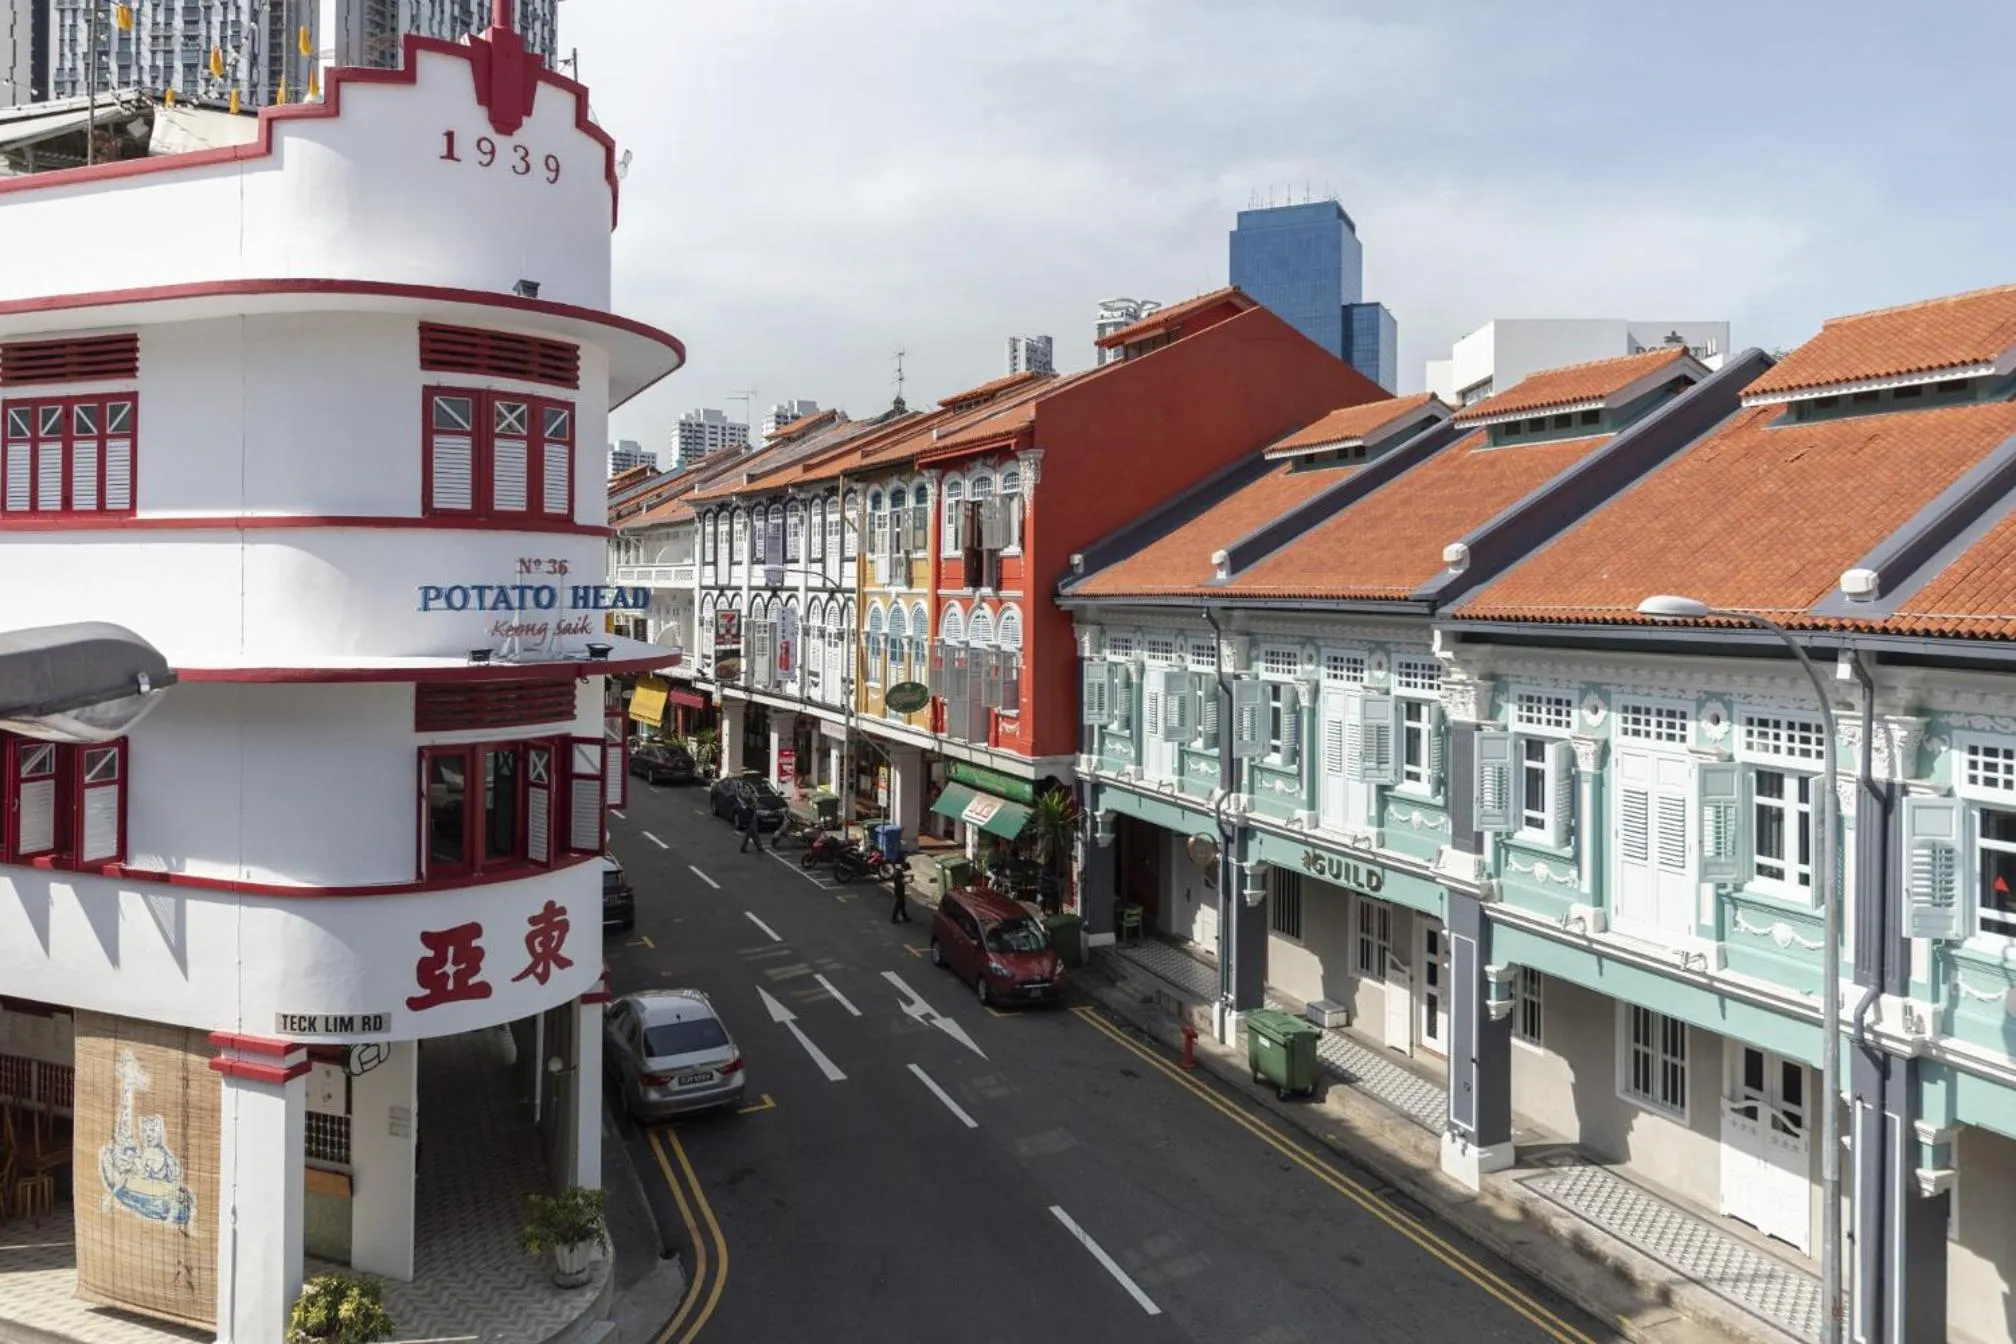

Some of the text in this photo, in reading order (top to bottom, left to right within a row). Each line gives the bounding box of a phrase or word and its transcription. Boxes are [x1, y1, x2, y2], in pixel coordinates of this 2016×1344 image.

[439, 129, 560, 185] 1939
[547, 558, 568, 576] 36
[417, 585, 652, 611] POTATO HEAD
[491, 619, 548, 646] Keong
[1313, 852, 1382, 892] GUILD
[281, 1014, 383, 1033] TECK LIM RD
